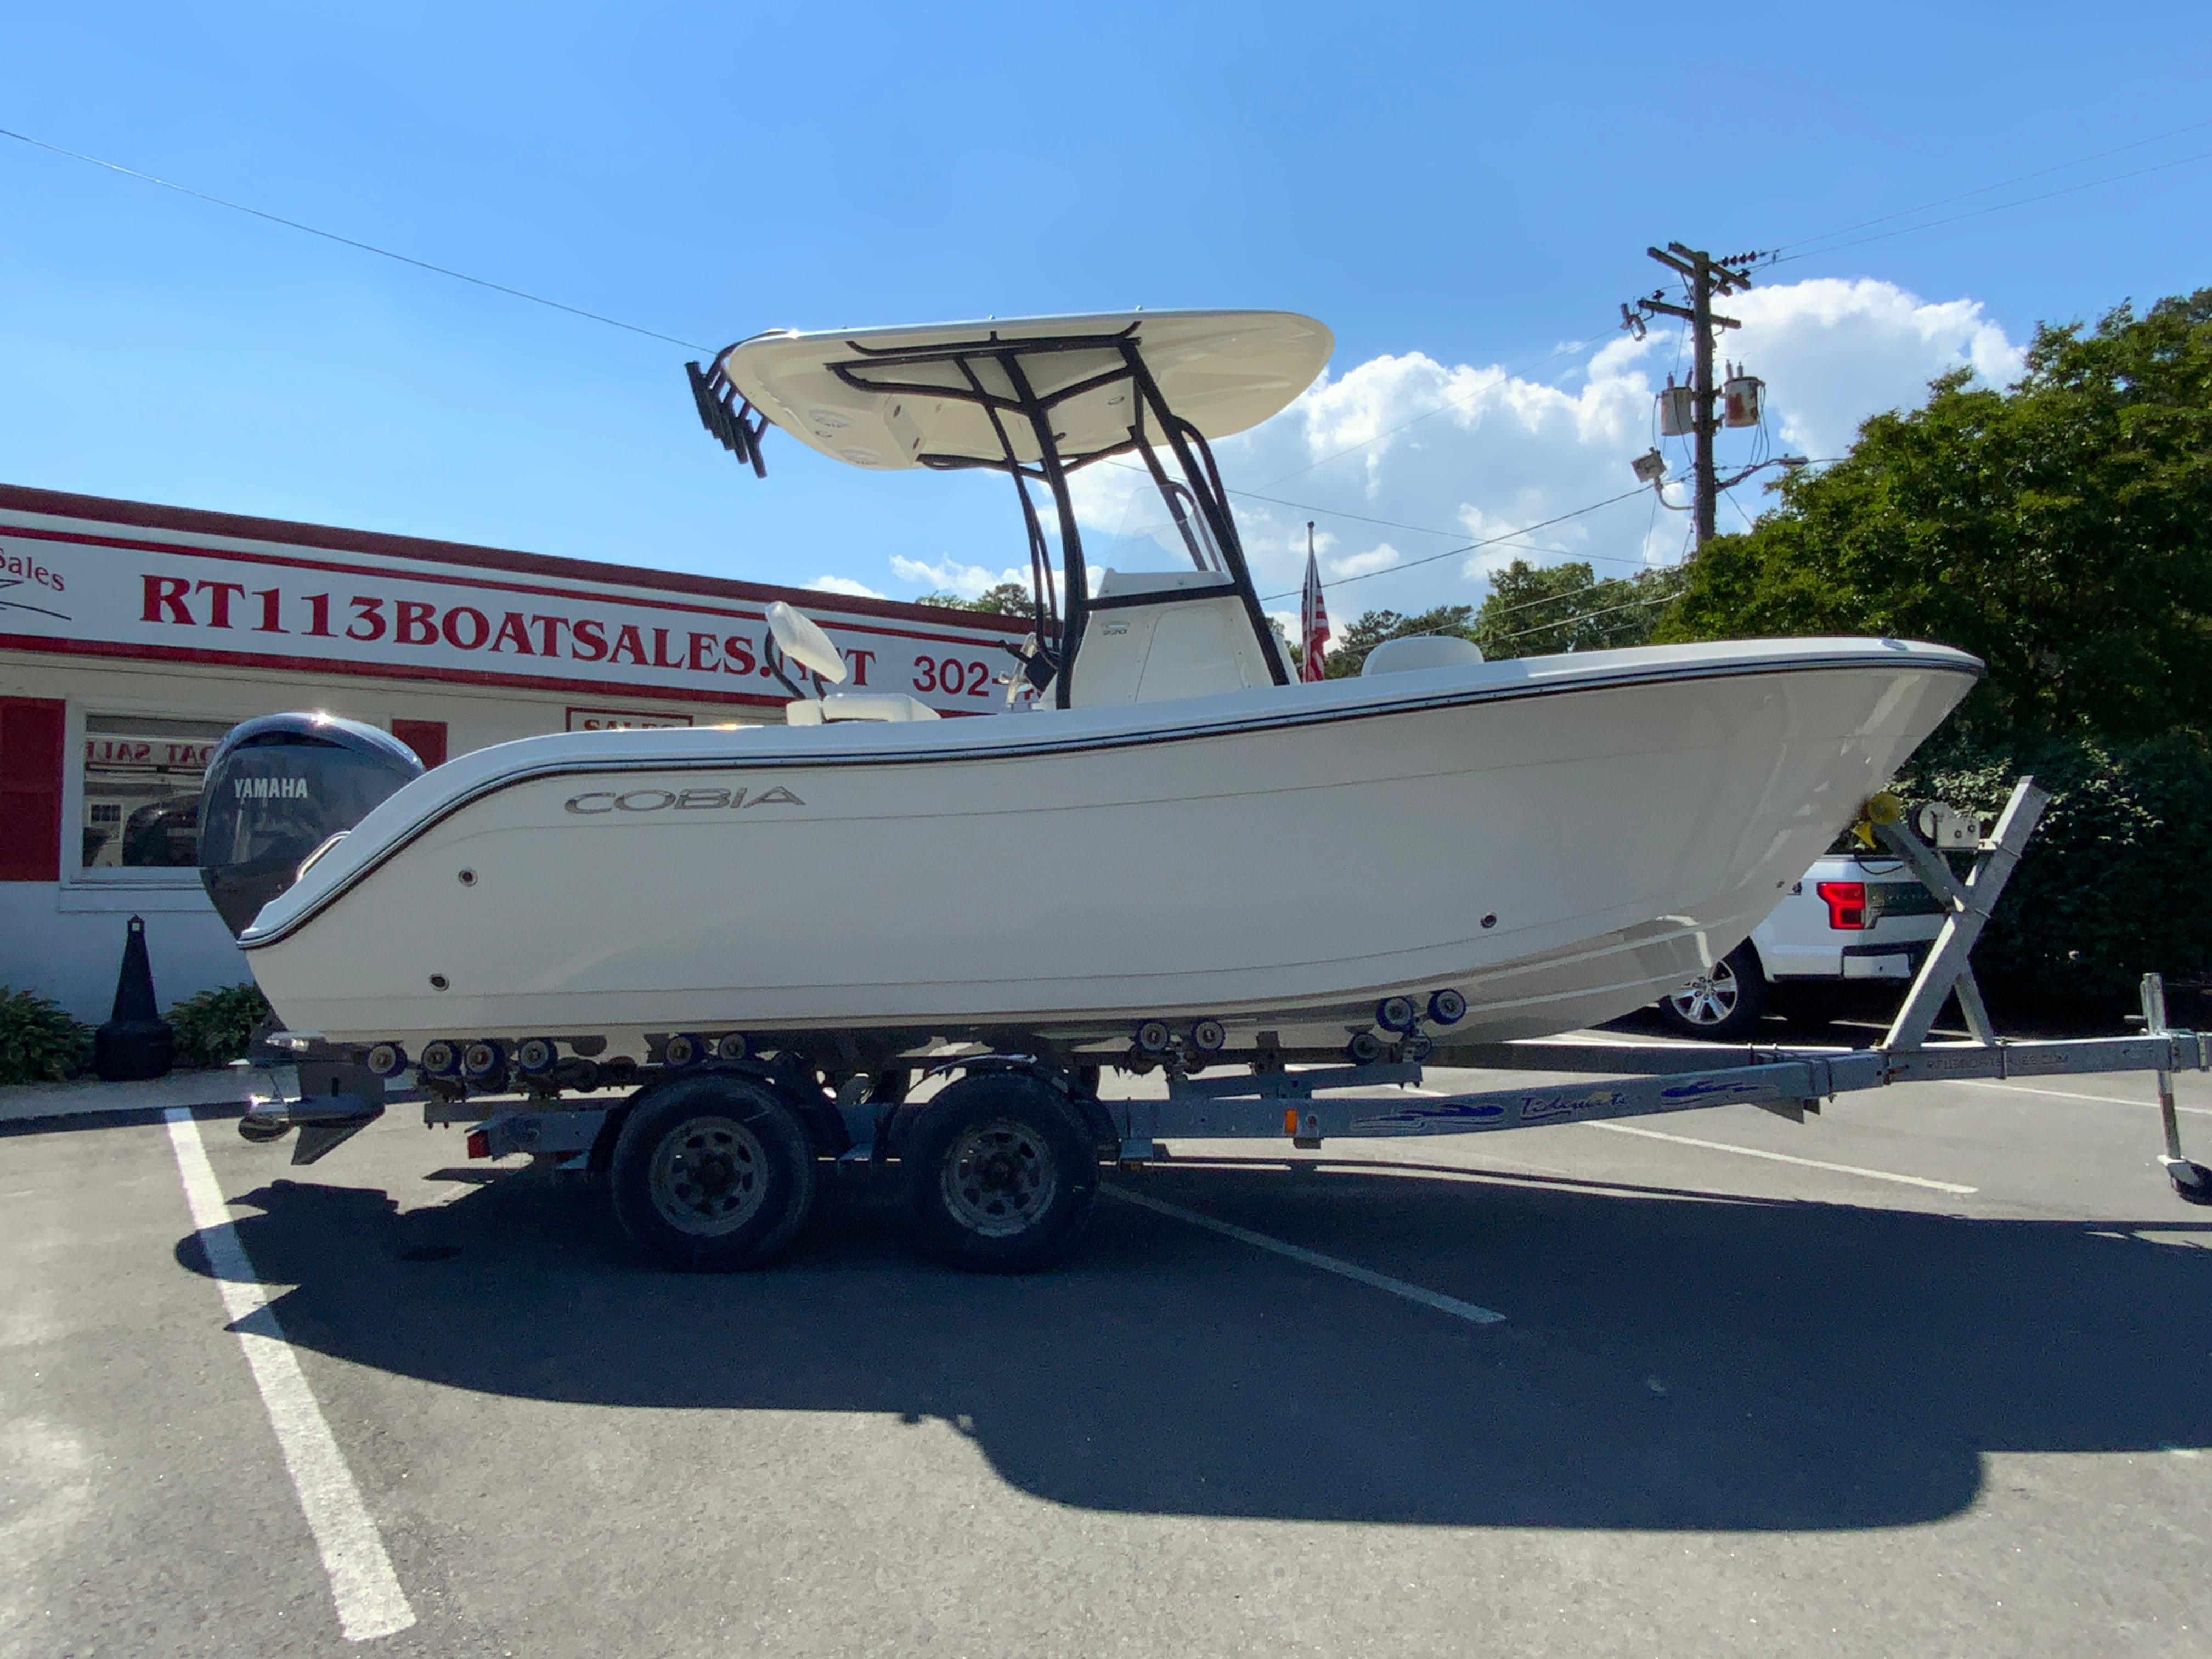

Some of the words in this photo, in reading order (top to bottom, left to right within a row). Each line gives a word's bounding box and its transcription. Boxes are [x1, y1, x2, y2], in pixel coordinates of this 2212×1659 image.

[140, 574, 876, 686] RT113BOATSALES.T
[234, 777, 308, 798] YAMAHA
[564, 785, 806, 814] COBIA
